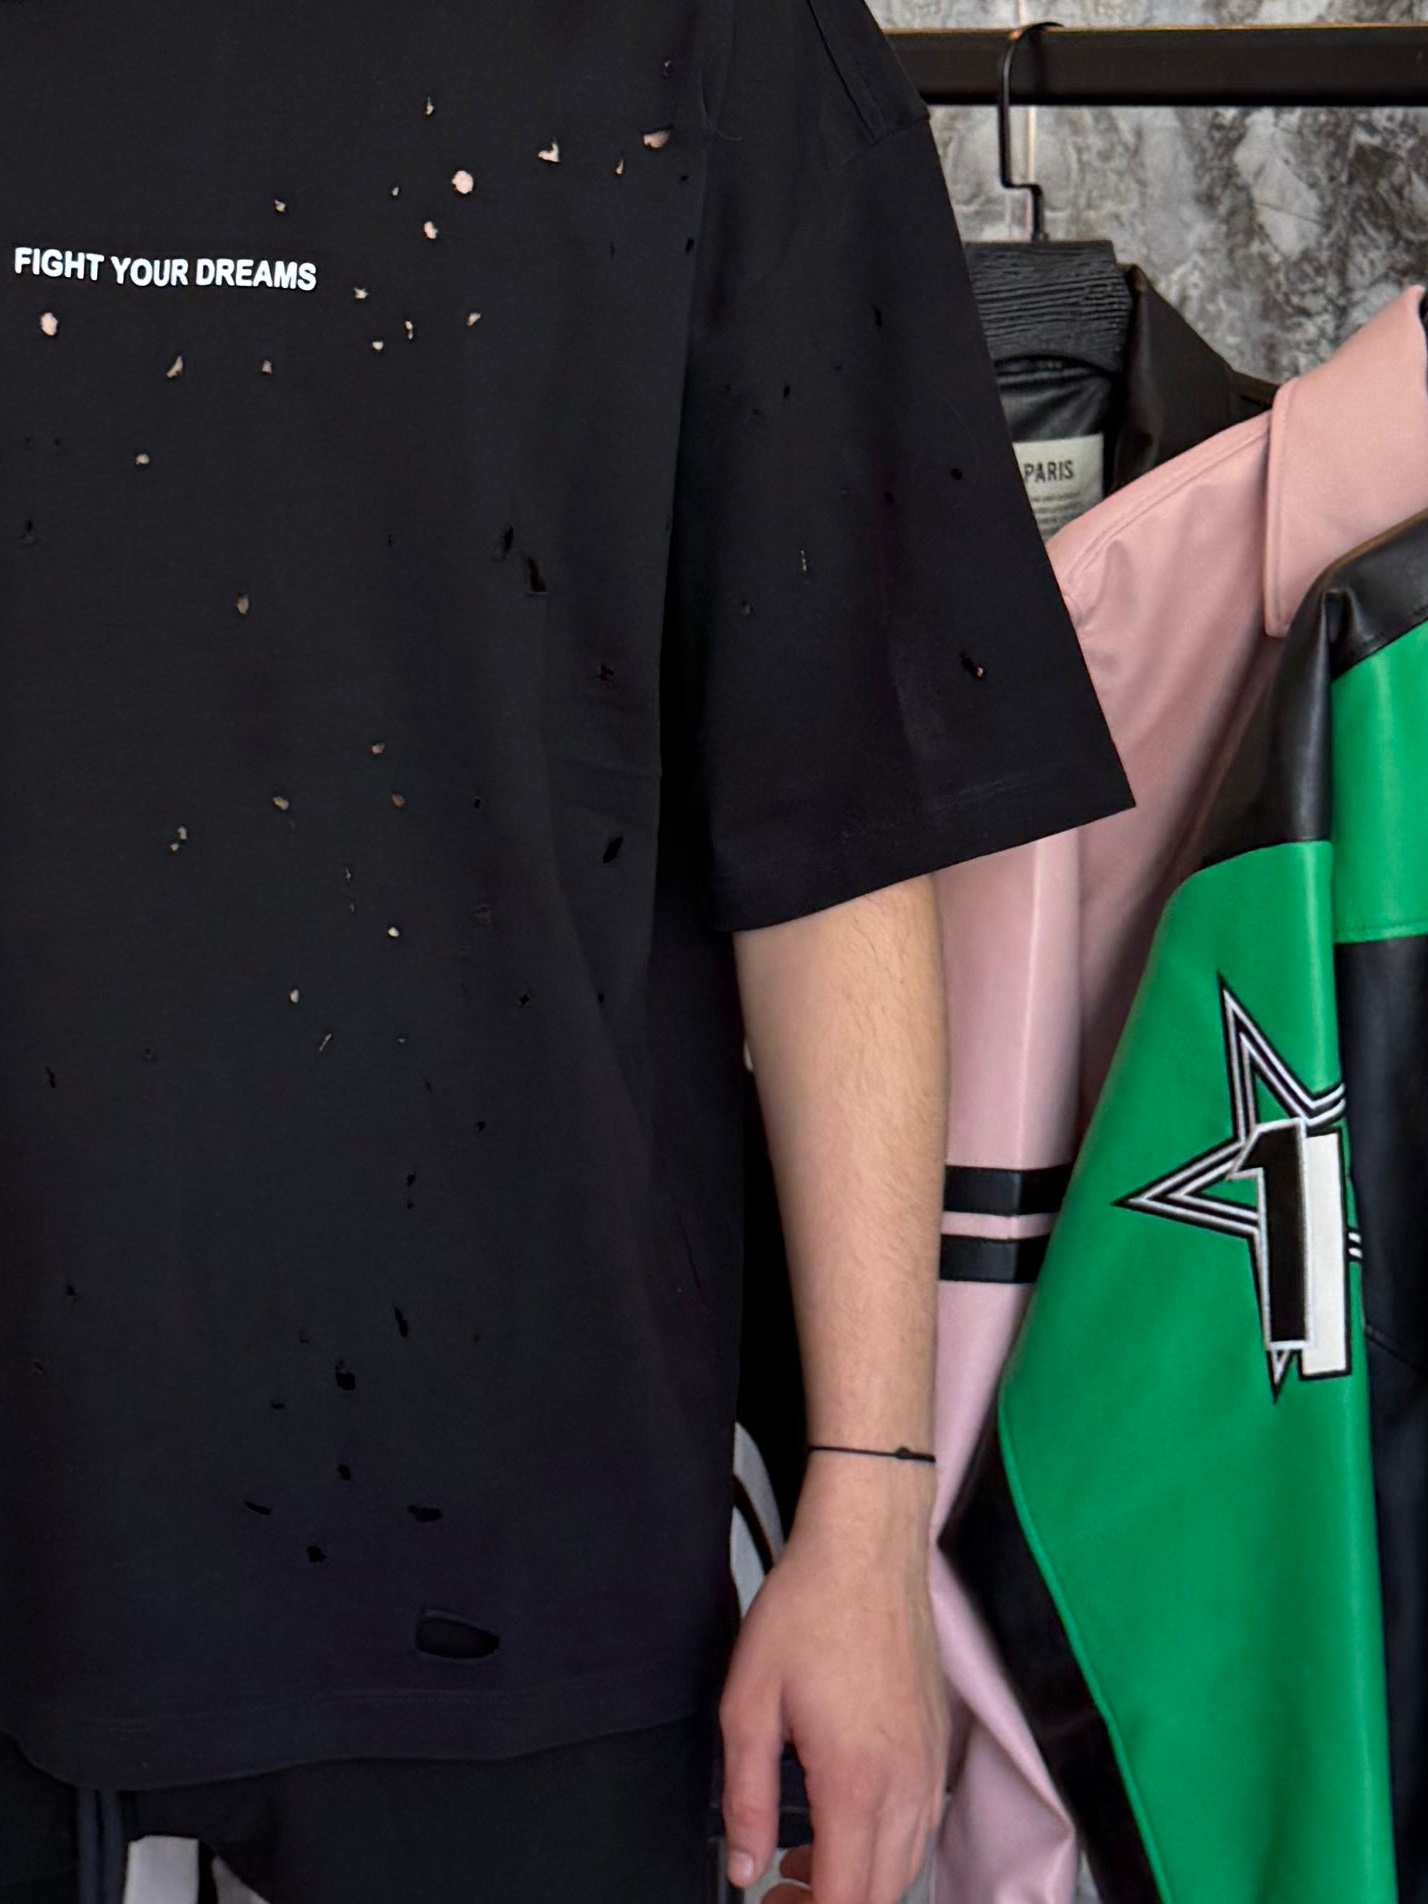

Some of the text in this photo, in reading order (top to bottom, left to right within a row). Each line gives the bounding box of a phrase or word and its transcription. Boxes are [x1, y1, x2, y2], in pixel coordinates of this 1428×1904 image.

[14, 246, 318, 291] FIGHT YOUR DREAMS
[1023, 459, 1075, 483] PARIS
